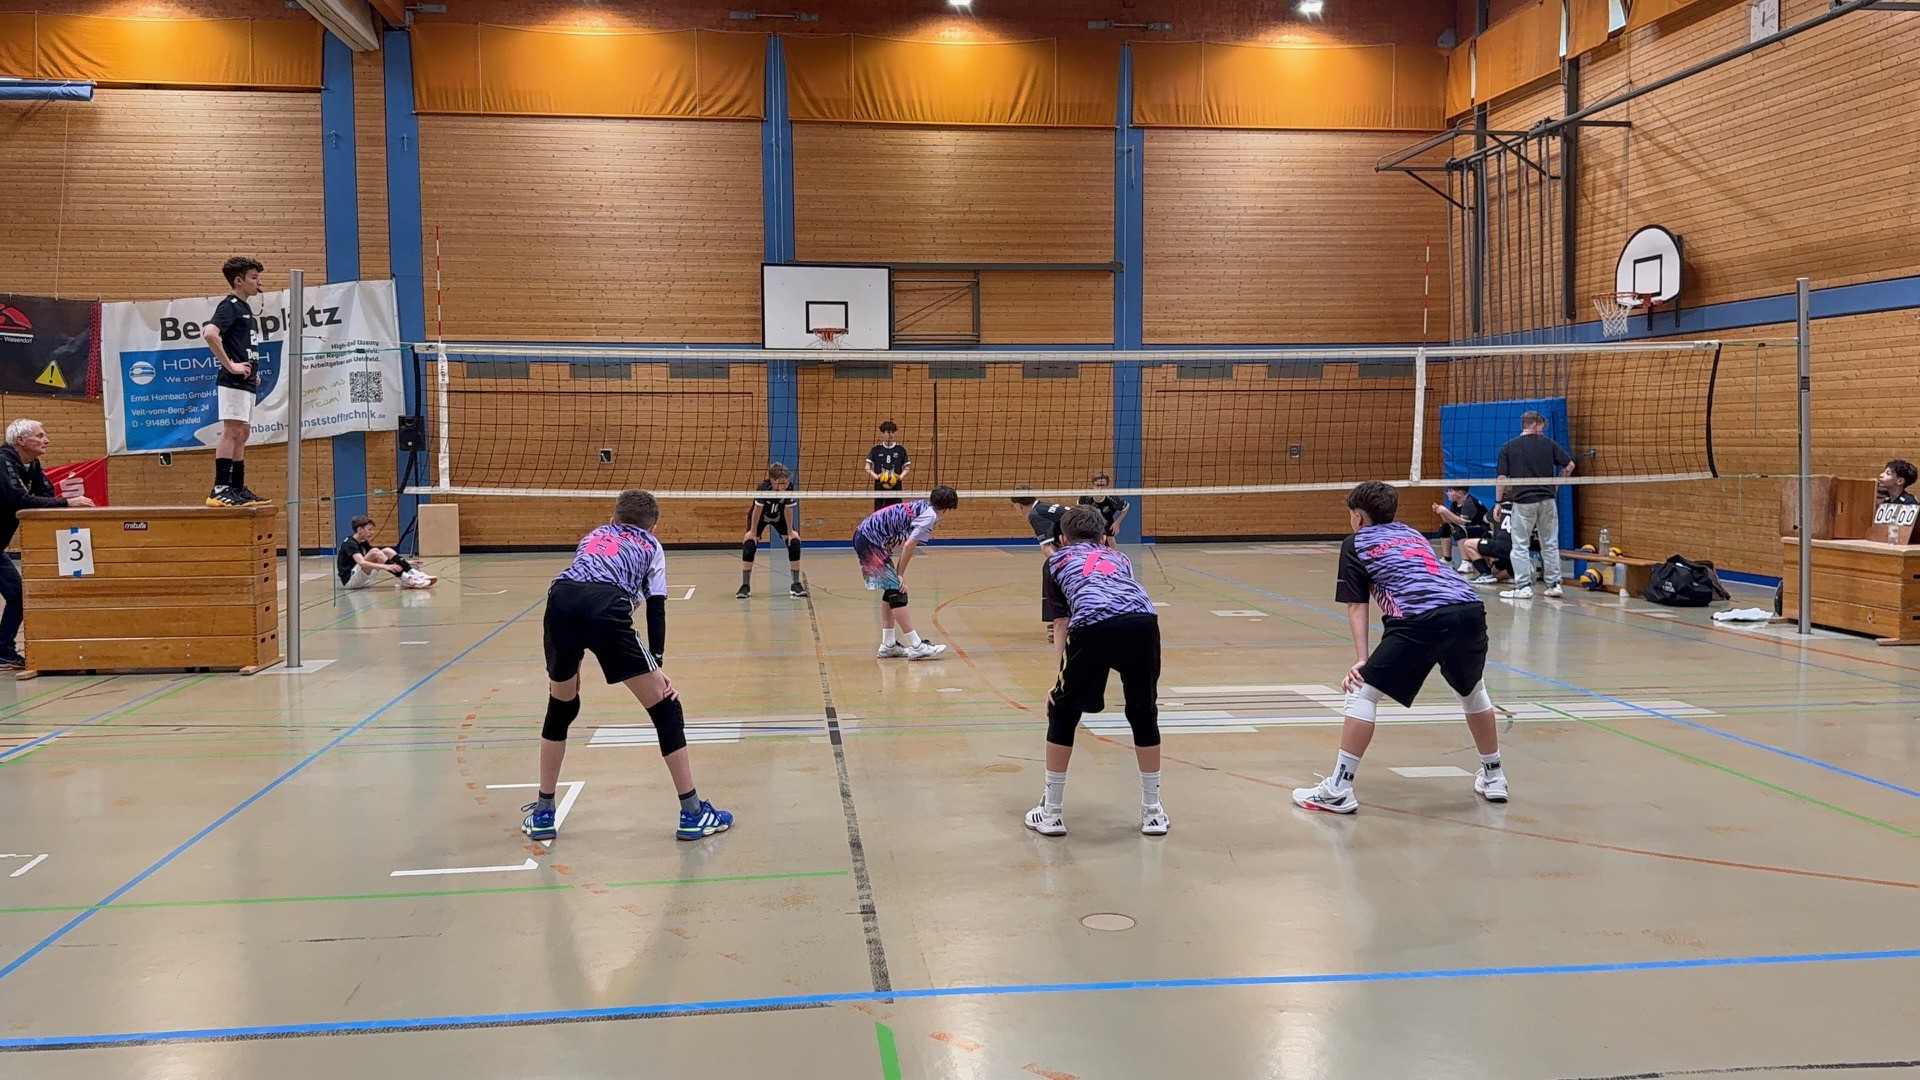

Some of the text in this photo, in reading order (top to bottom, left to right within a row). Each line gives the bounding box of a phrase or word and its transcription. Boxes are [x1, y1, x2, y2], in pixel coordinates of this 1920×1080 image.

[310, 359, 345, 369] Arbeitgeber
[131, 389, 217, 402] Ernst Hombach GmbH &
[201, 403, 210, 411] 24
[145, 418, 170, 427] 91486
[69, 539, 84, 561] 3
[1401, 547, 1440, 575] 7
